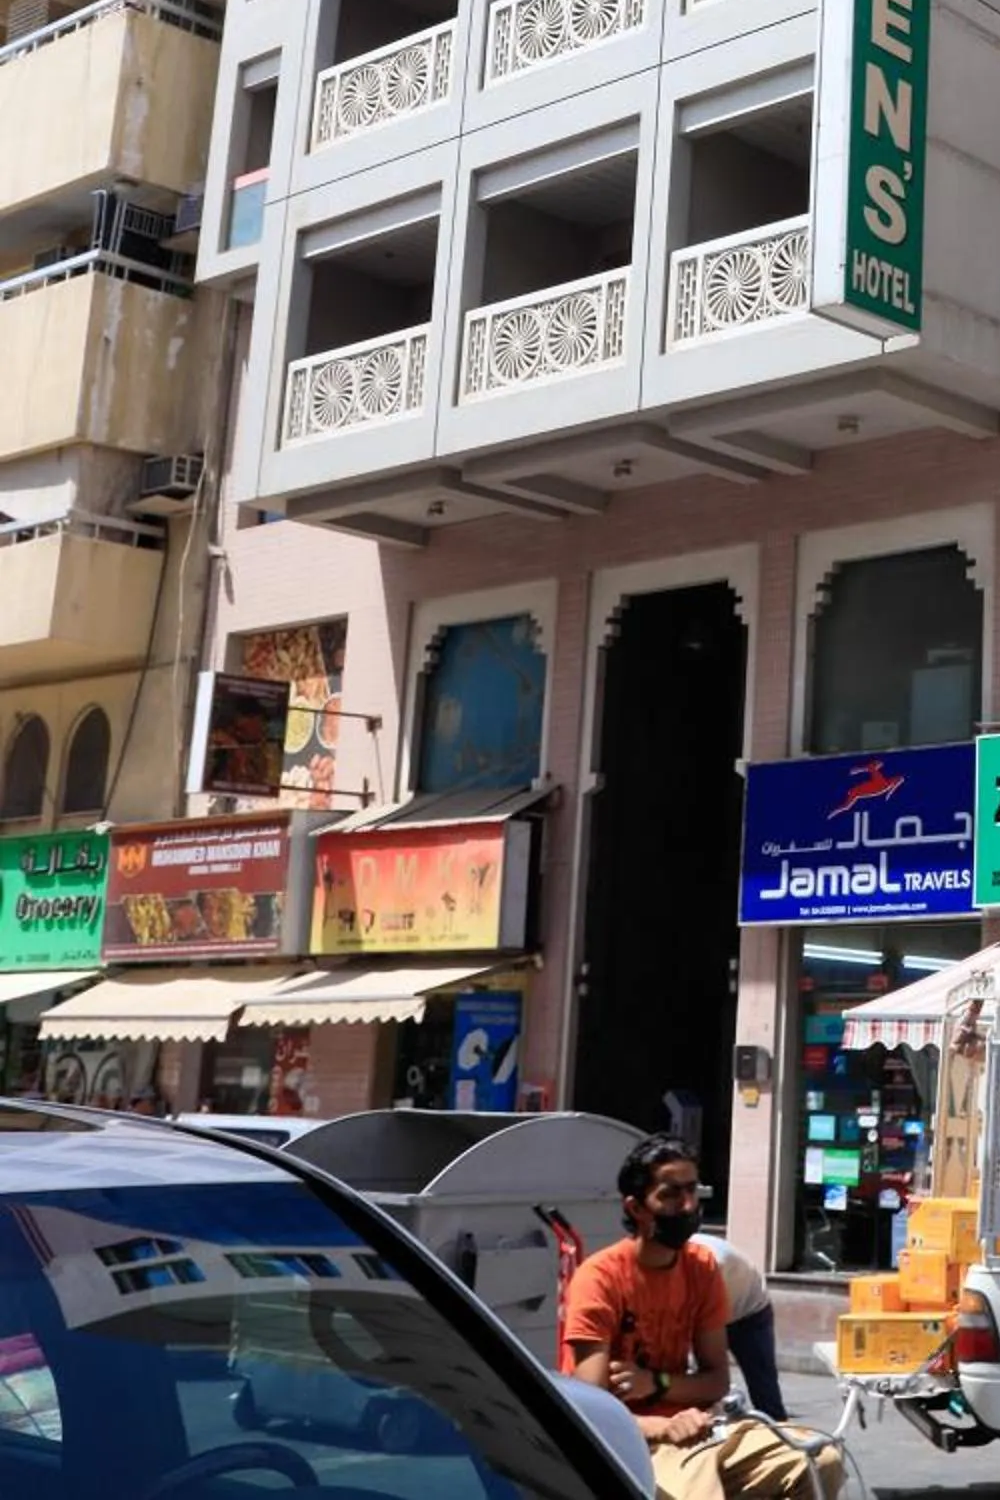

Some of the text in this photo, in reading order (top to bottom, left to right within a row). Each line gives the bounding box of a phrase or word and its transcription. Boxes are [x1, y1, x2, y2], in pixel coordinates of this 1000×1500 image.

[852, 249, 915, 314] HOTEL
[836, 811, 973, 850] جمال
[21, 842, 104, 878] بقالة
[903, 869, 971, 892] TRAVELS
[16, 893, 98, 925] Grocery
